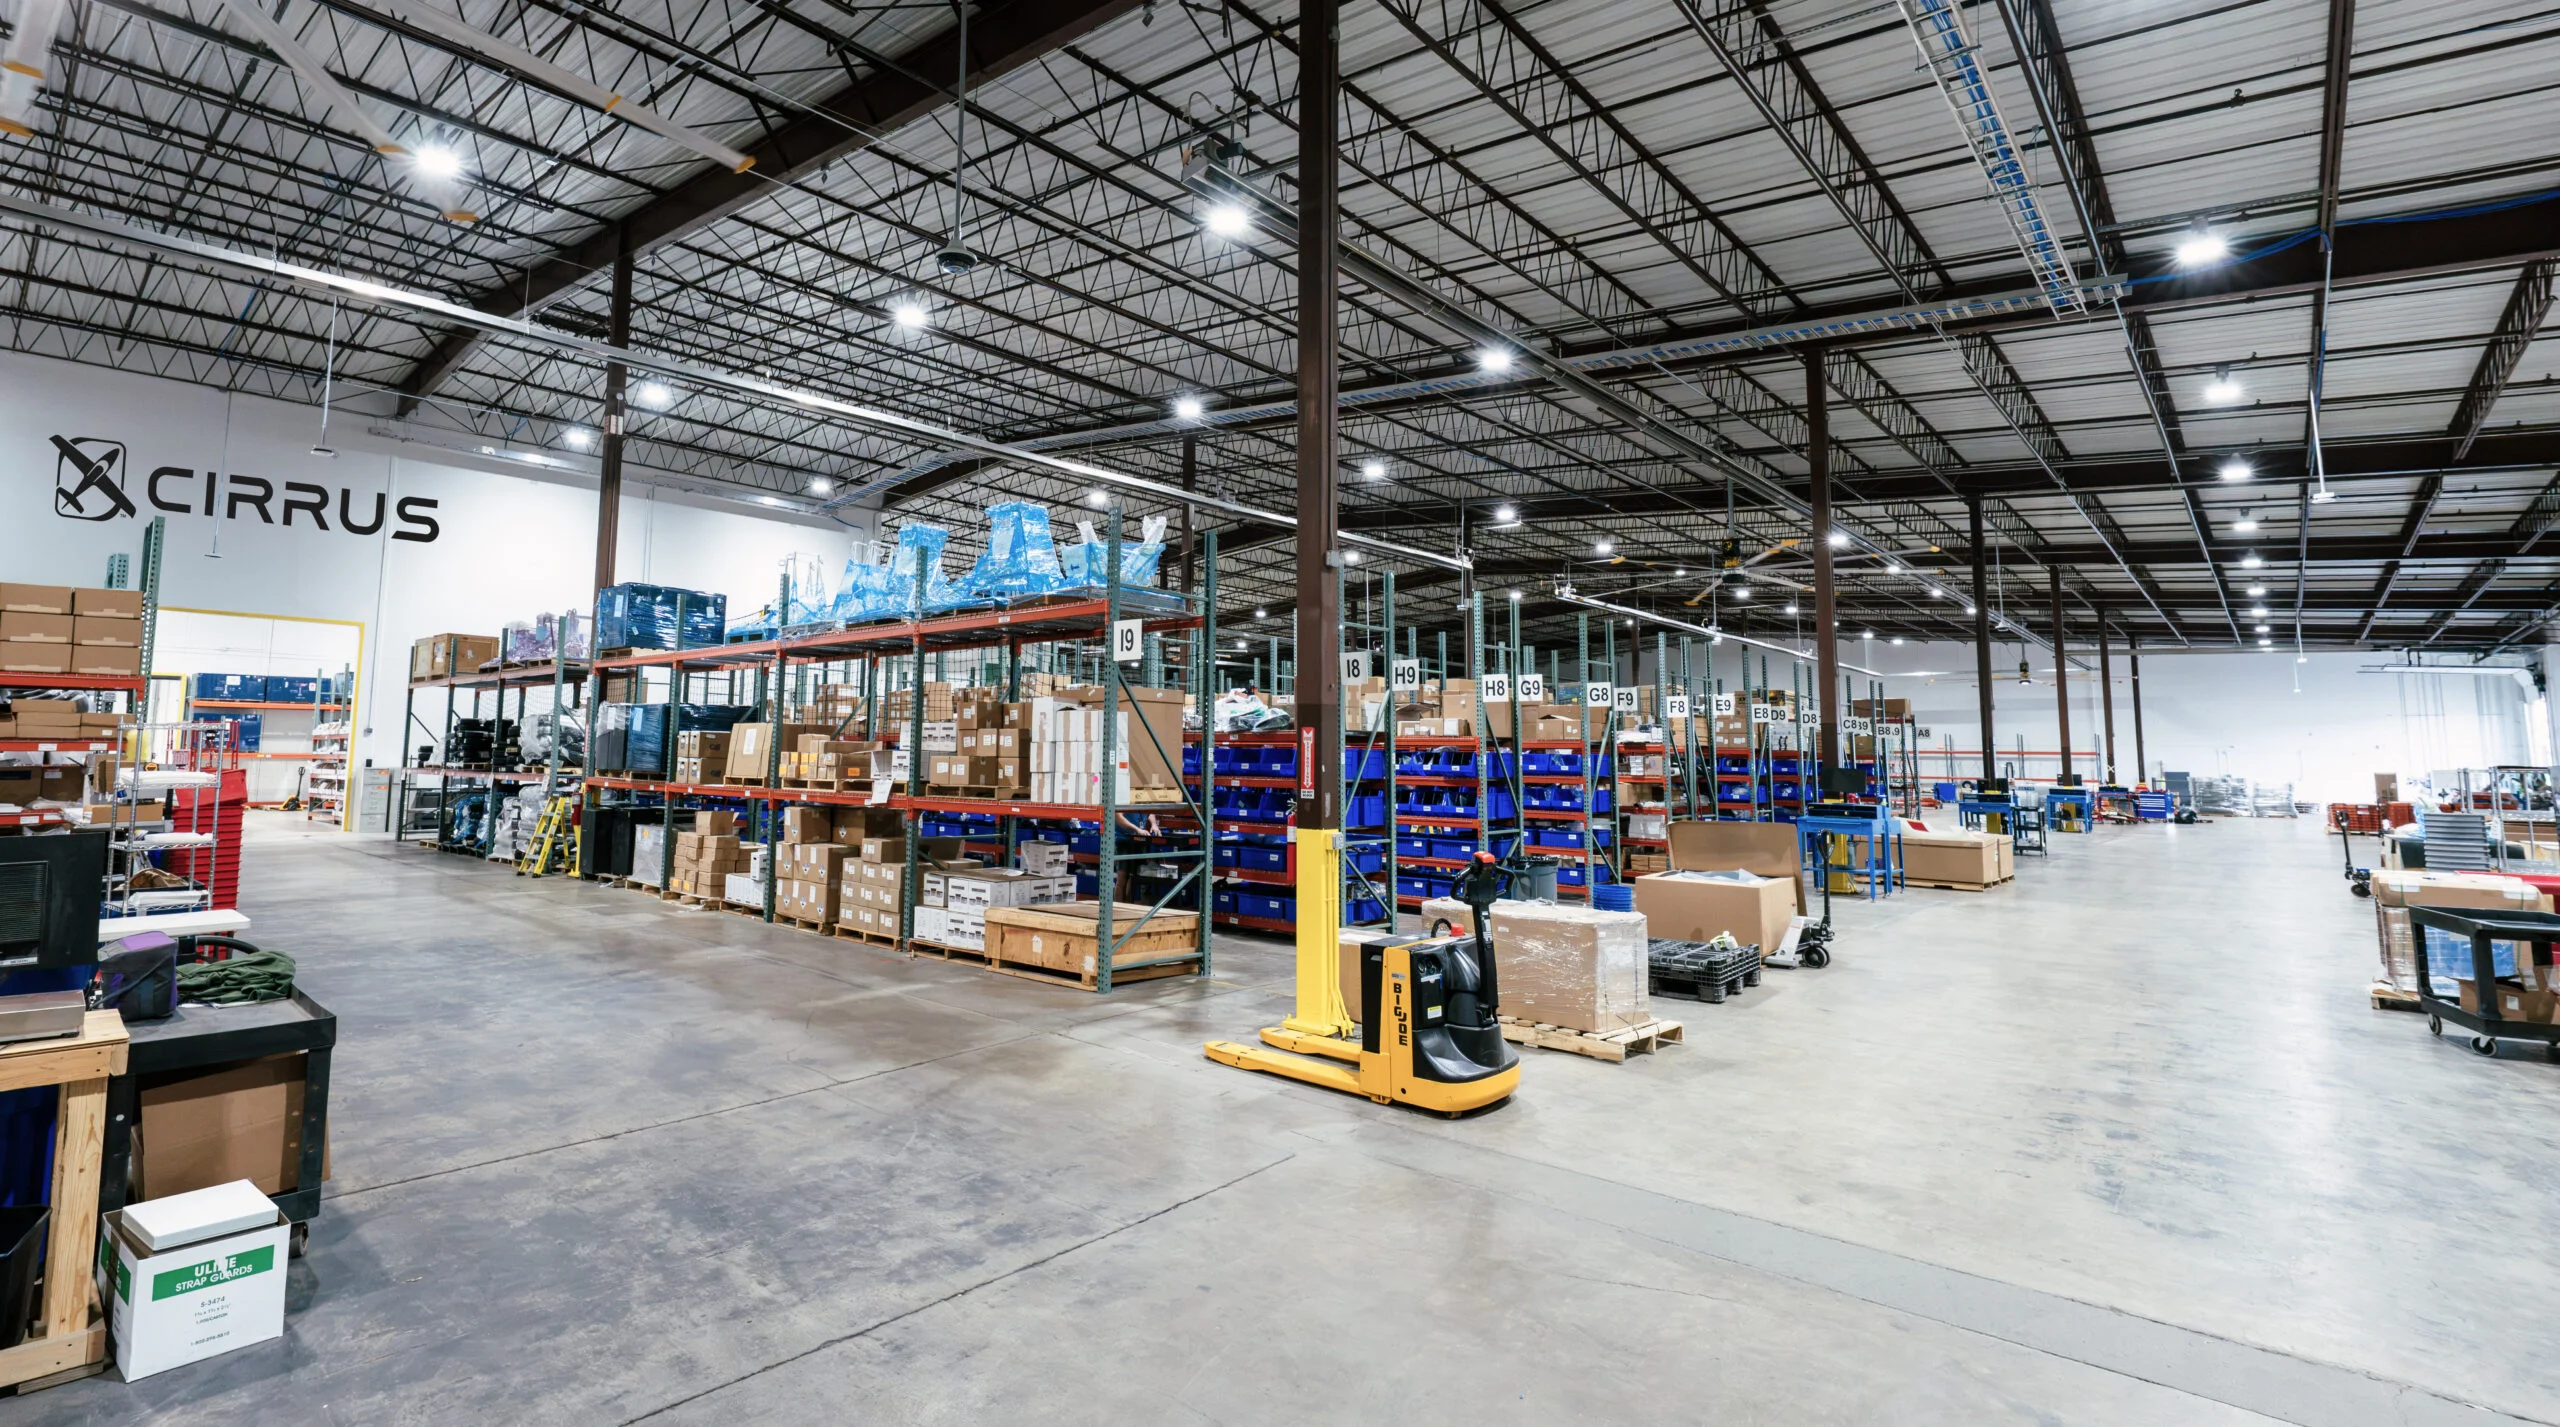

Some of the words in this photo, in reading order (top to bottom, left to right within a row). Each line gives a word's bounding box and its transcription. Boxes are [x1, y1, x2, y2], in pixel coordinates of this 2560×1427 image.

[147, 466, 440, 543] CIRRUS
[1120, 628, 1134, 652] I9
[1346, 658, 1361, 678] I8
[1394, 666, 1416, 684] H9
[1485, 680, 1505, 696] H8
[1520, 680, 1540, 696] G9
[1589, 687, 1609, 701] G8
[1617, 692, 1634, 706] F9
[1715, 699, 1731, 712] E9
[1669, 700, 1685, 713] F8
[1754, 707, 1769, 719] E8
[1771, 709, 1786, 721] D9
[1802, 713, 1817, 724] D8
[1843, 719, 1857, 729] C8
[1877, 726, 1891, 735] B8
[1917, 729, 1930, 738] A8
[194, 1256, 237, 1277] ULIE
[175, 1276, 207, 1292] STRAP
[210, 1264, 253, 1282] GUARDS
